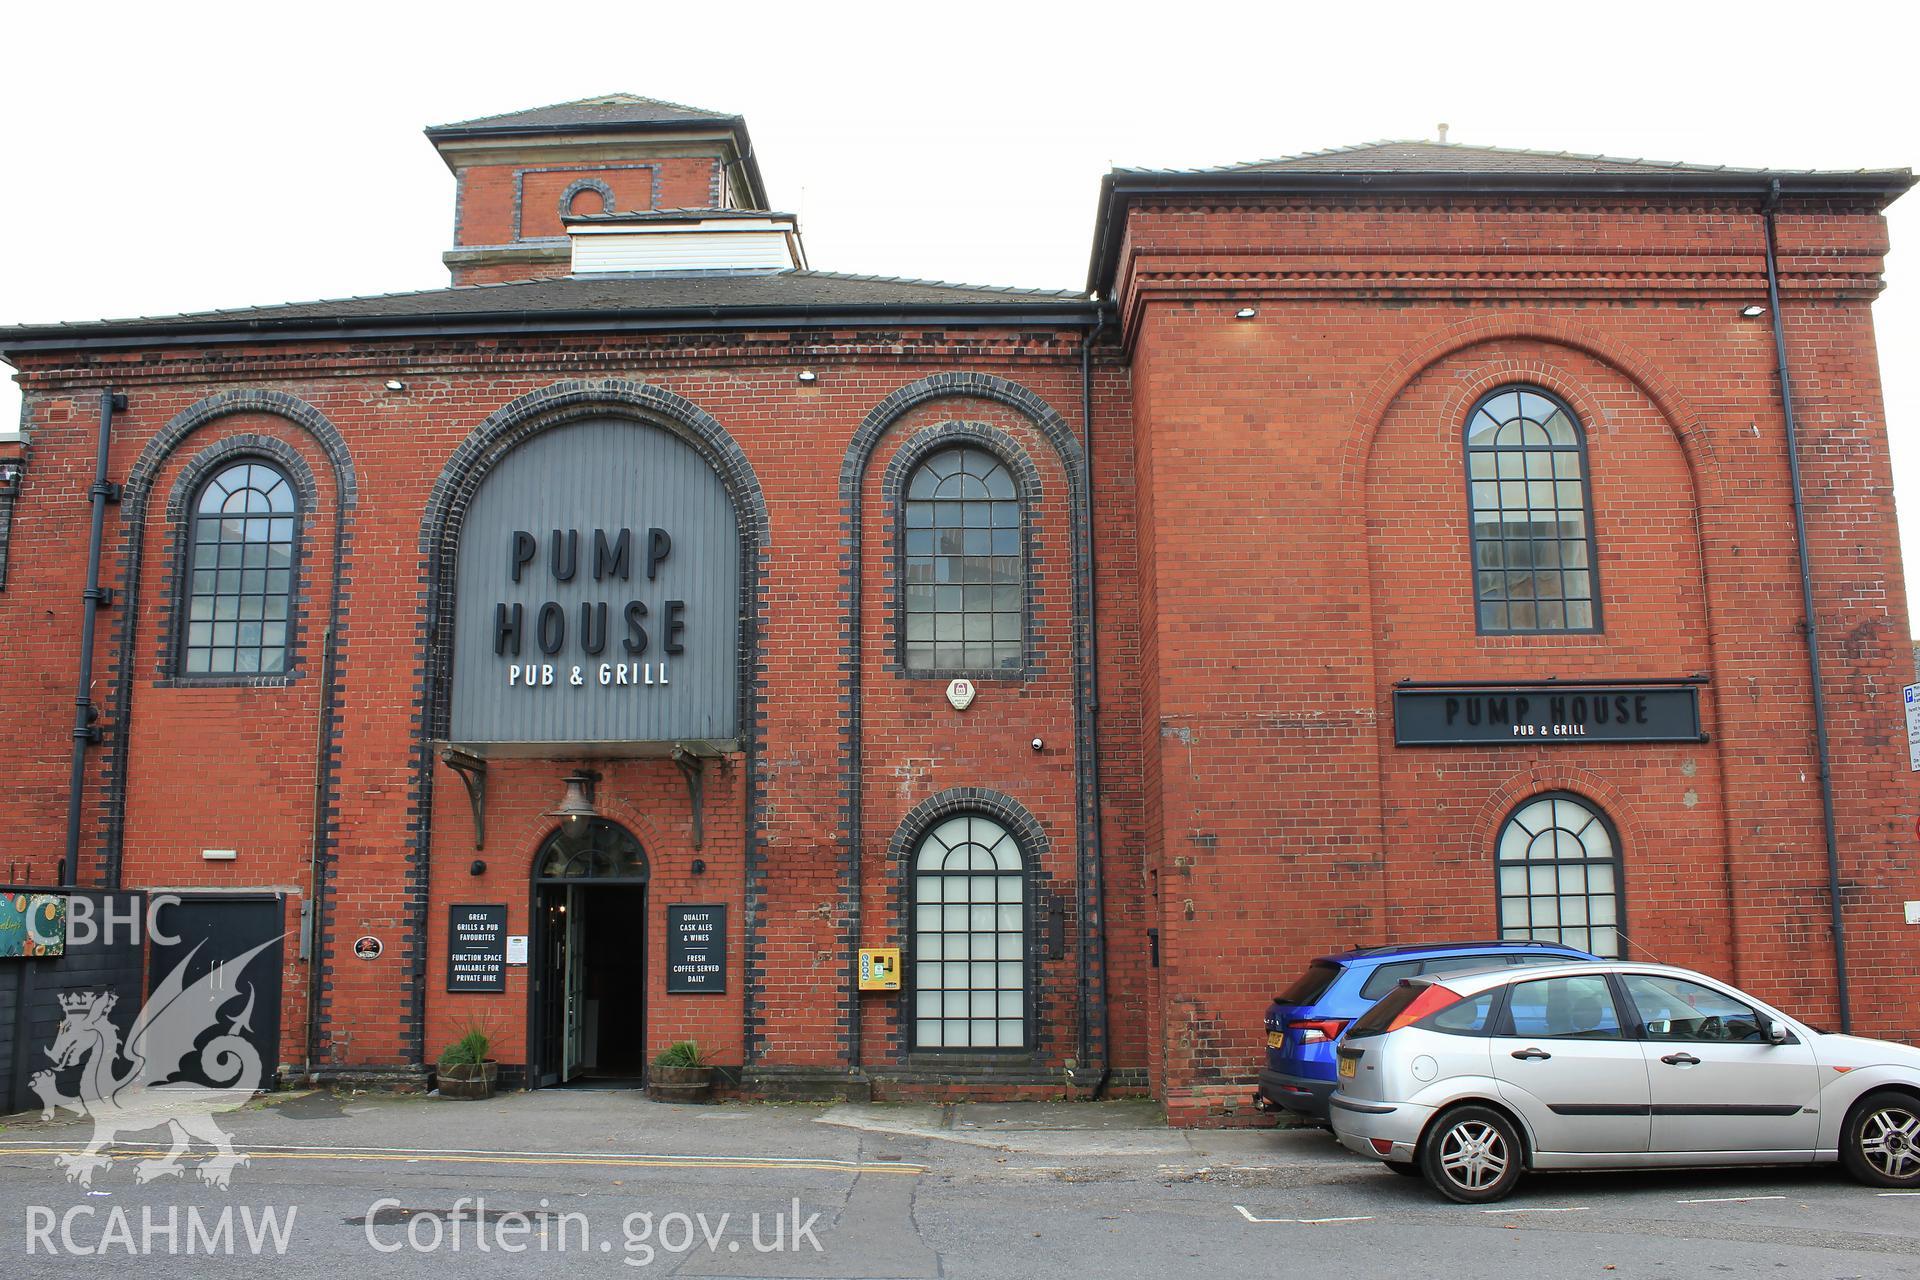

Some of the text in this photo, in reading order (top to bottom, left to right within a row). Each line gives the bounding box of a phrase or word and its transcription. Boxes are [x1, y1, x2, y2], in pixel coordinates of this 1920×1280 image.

[511, 527, 672, 582] PUMP
[493, 600, 685, 656] HOUSE
[509, 662, 669, 686] PUB & GRILL
[1444, 695, 1649, 726] PUMP HOUSE
[1513, 724, 1585, 736] PUB & GRILL
